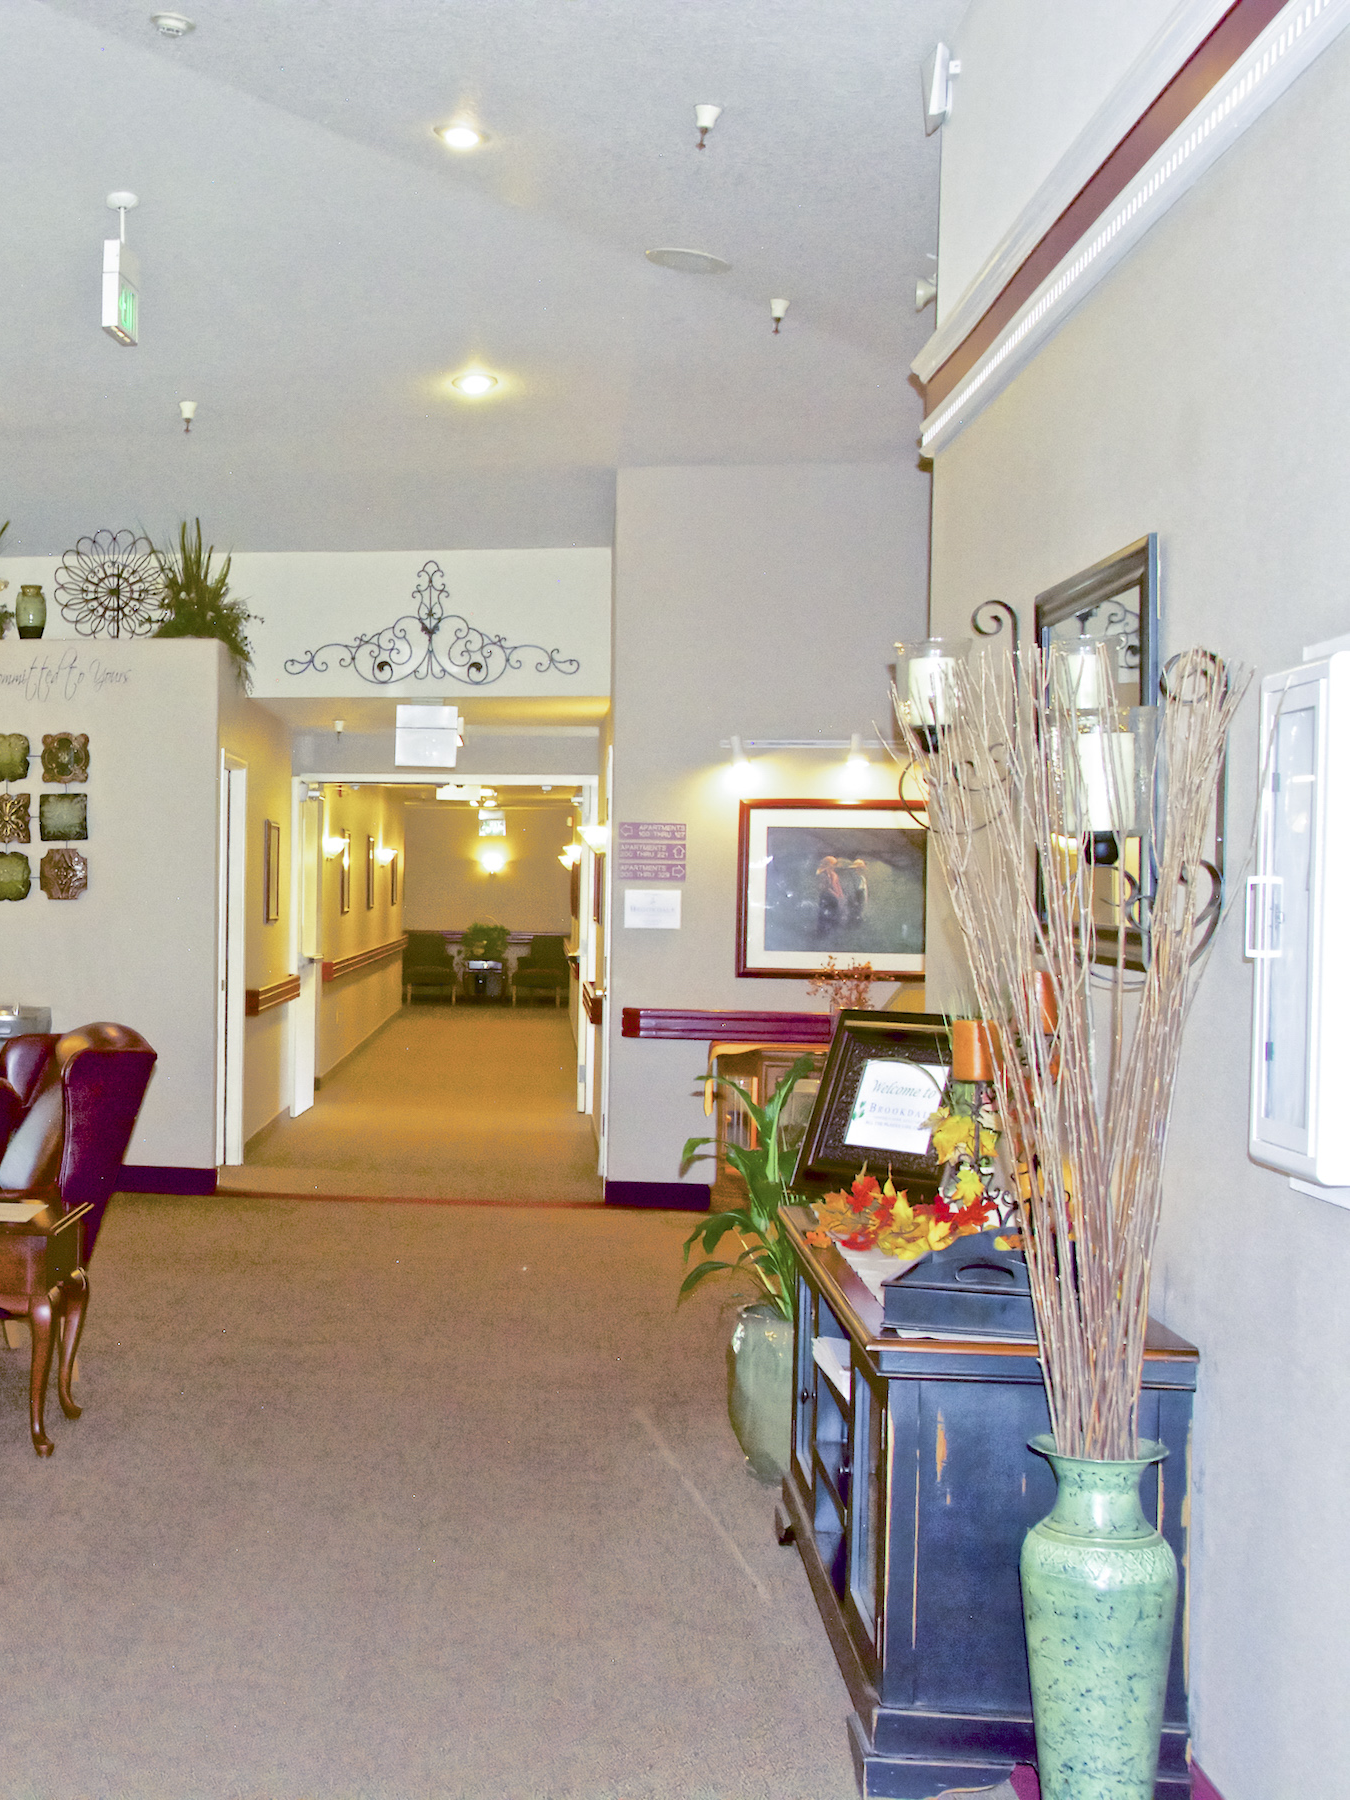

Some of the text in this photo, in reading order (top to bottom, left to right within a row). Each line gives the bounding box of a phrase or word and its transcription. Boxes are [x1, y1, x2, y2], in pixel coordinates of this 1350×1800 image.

[89, 658, 132, 692] Yours
[638, 824, 685, 832] APARTMENTS
[621, 844, 666, 852] APARTMENTS
[872, 1080, 937, 1099] Welcome to
[869, 1102, 928, 1119] BROOKDAL
